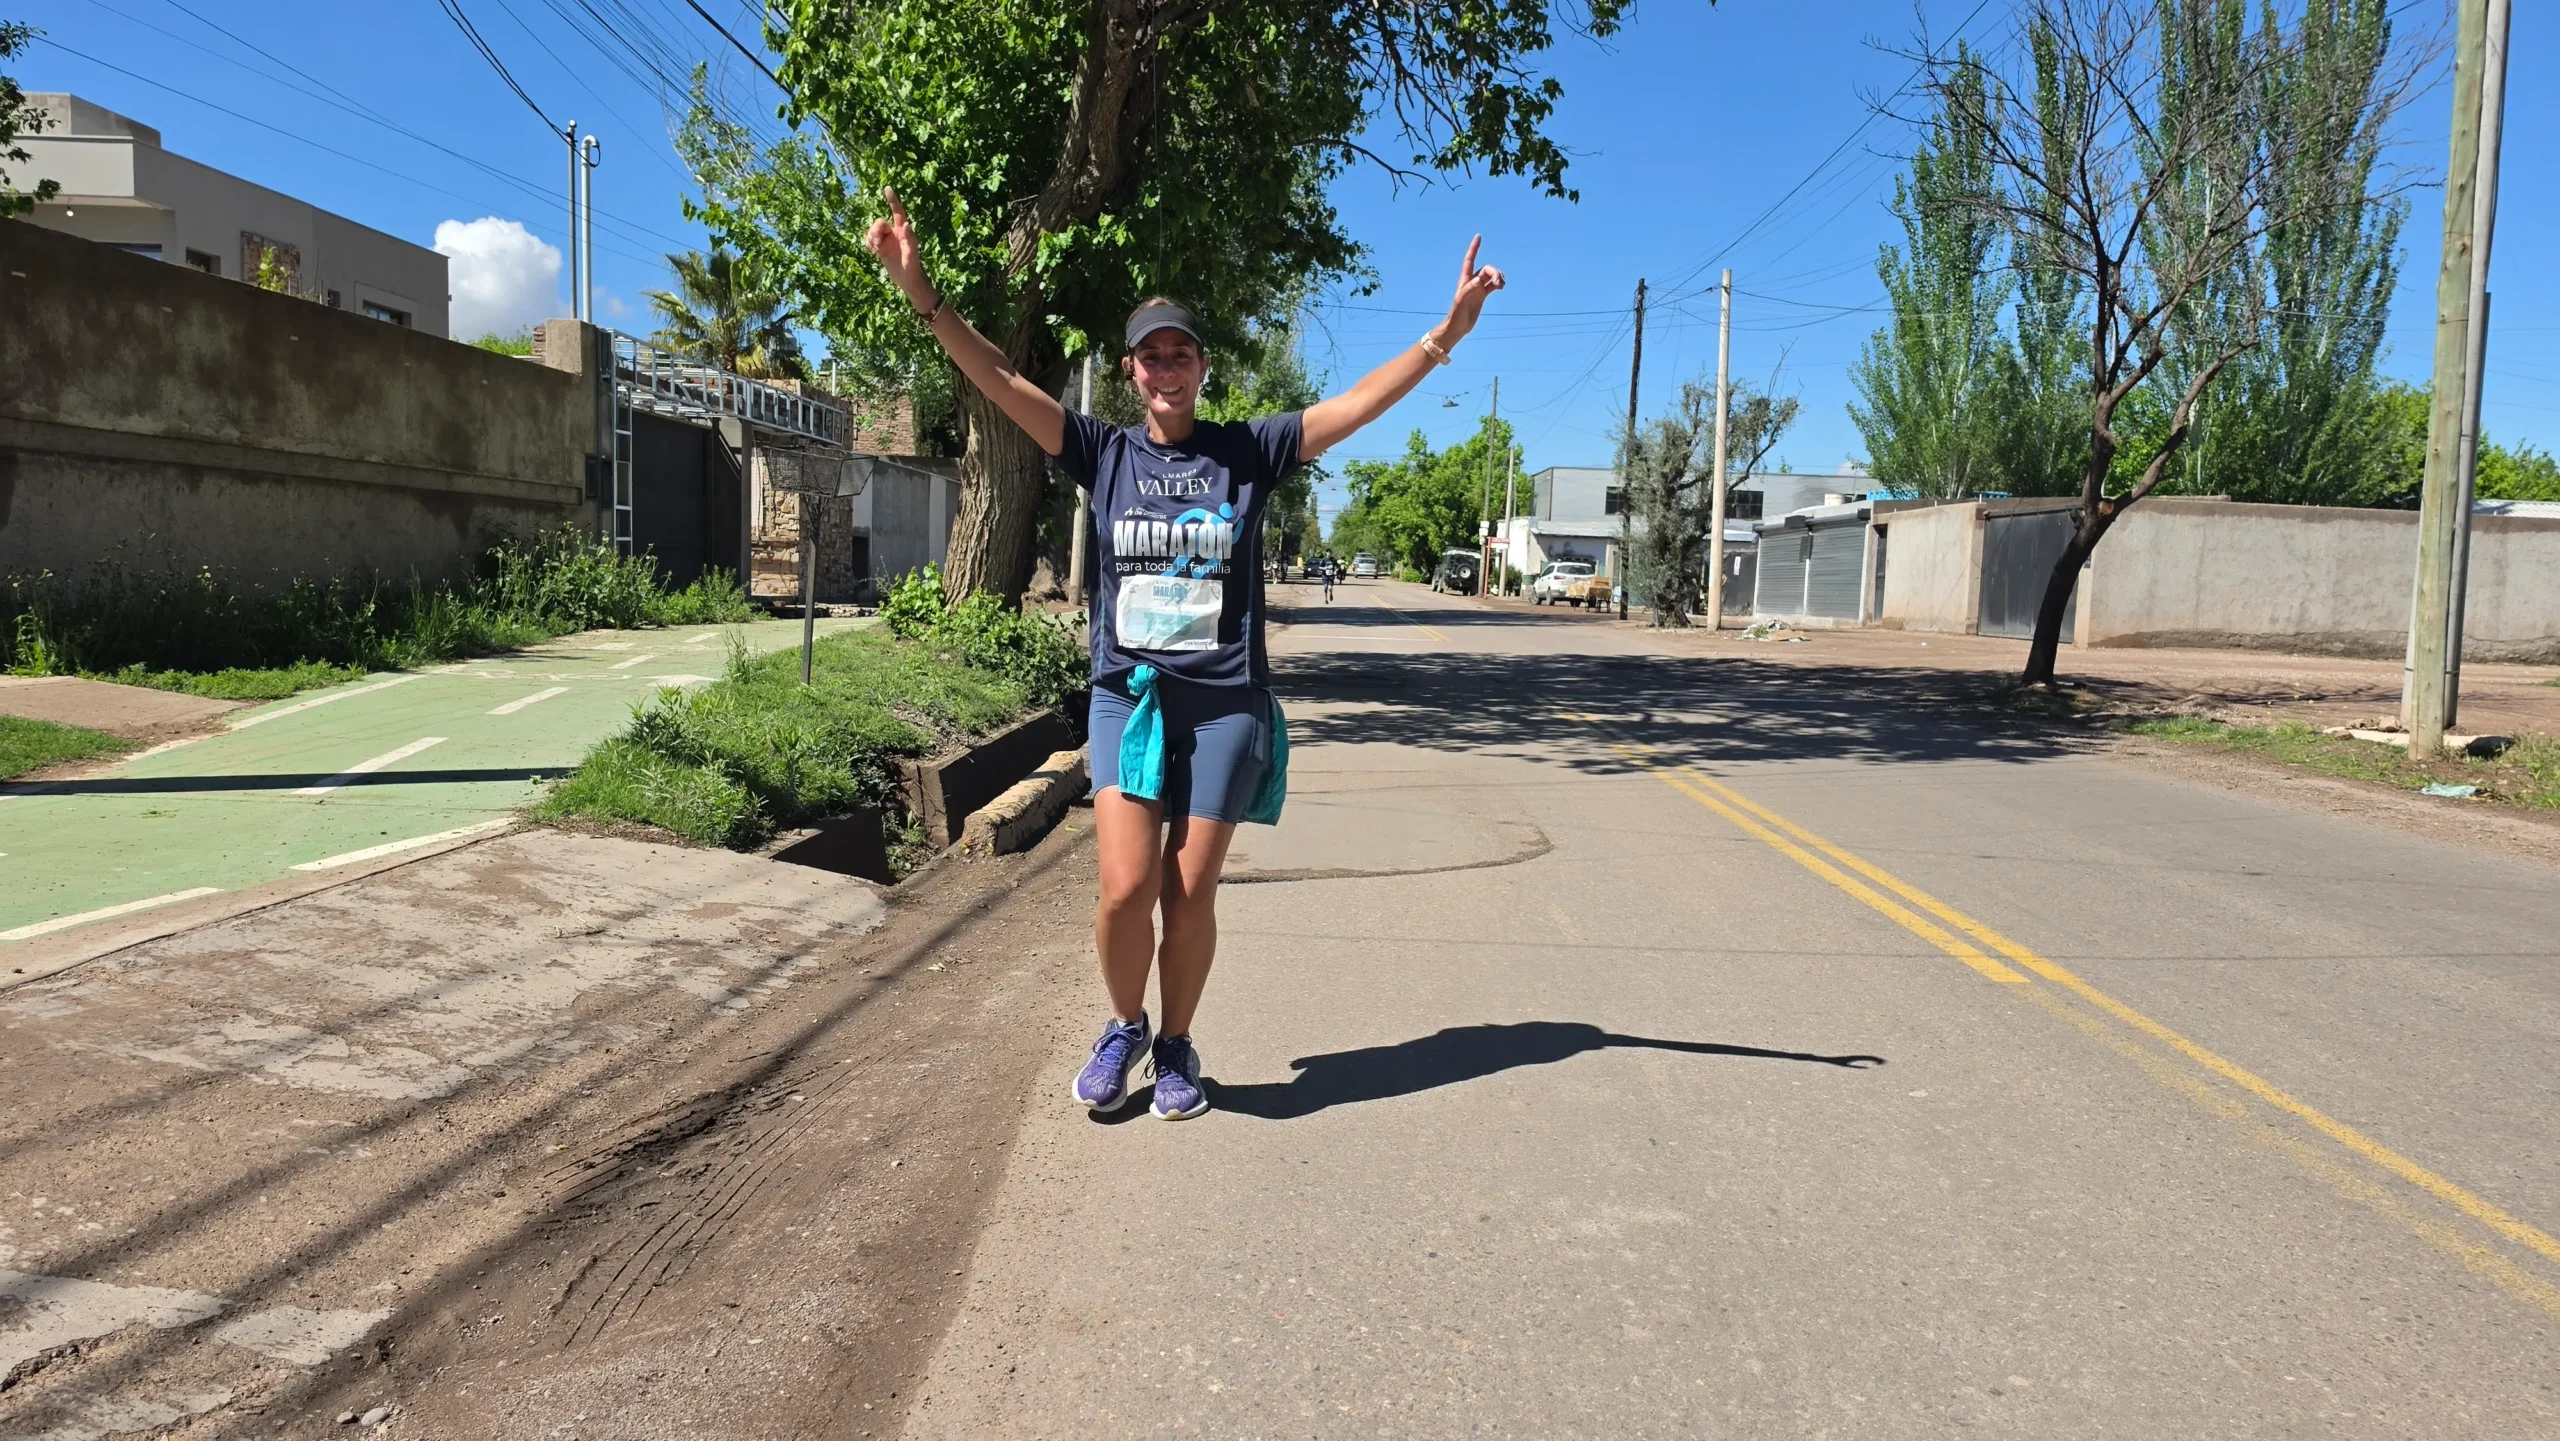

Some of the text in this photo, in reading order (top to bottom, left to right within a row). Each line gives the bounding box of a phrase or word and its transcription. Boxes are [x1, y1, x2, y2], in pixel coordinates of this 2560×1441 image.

[1137, 476, 1213, 497] VALLEY
[1113, 513, 1234, 560] MARATÓN
[1116, 560, 1231, 574] para toda la familia
